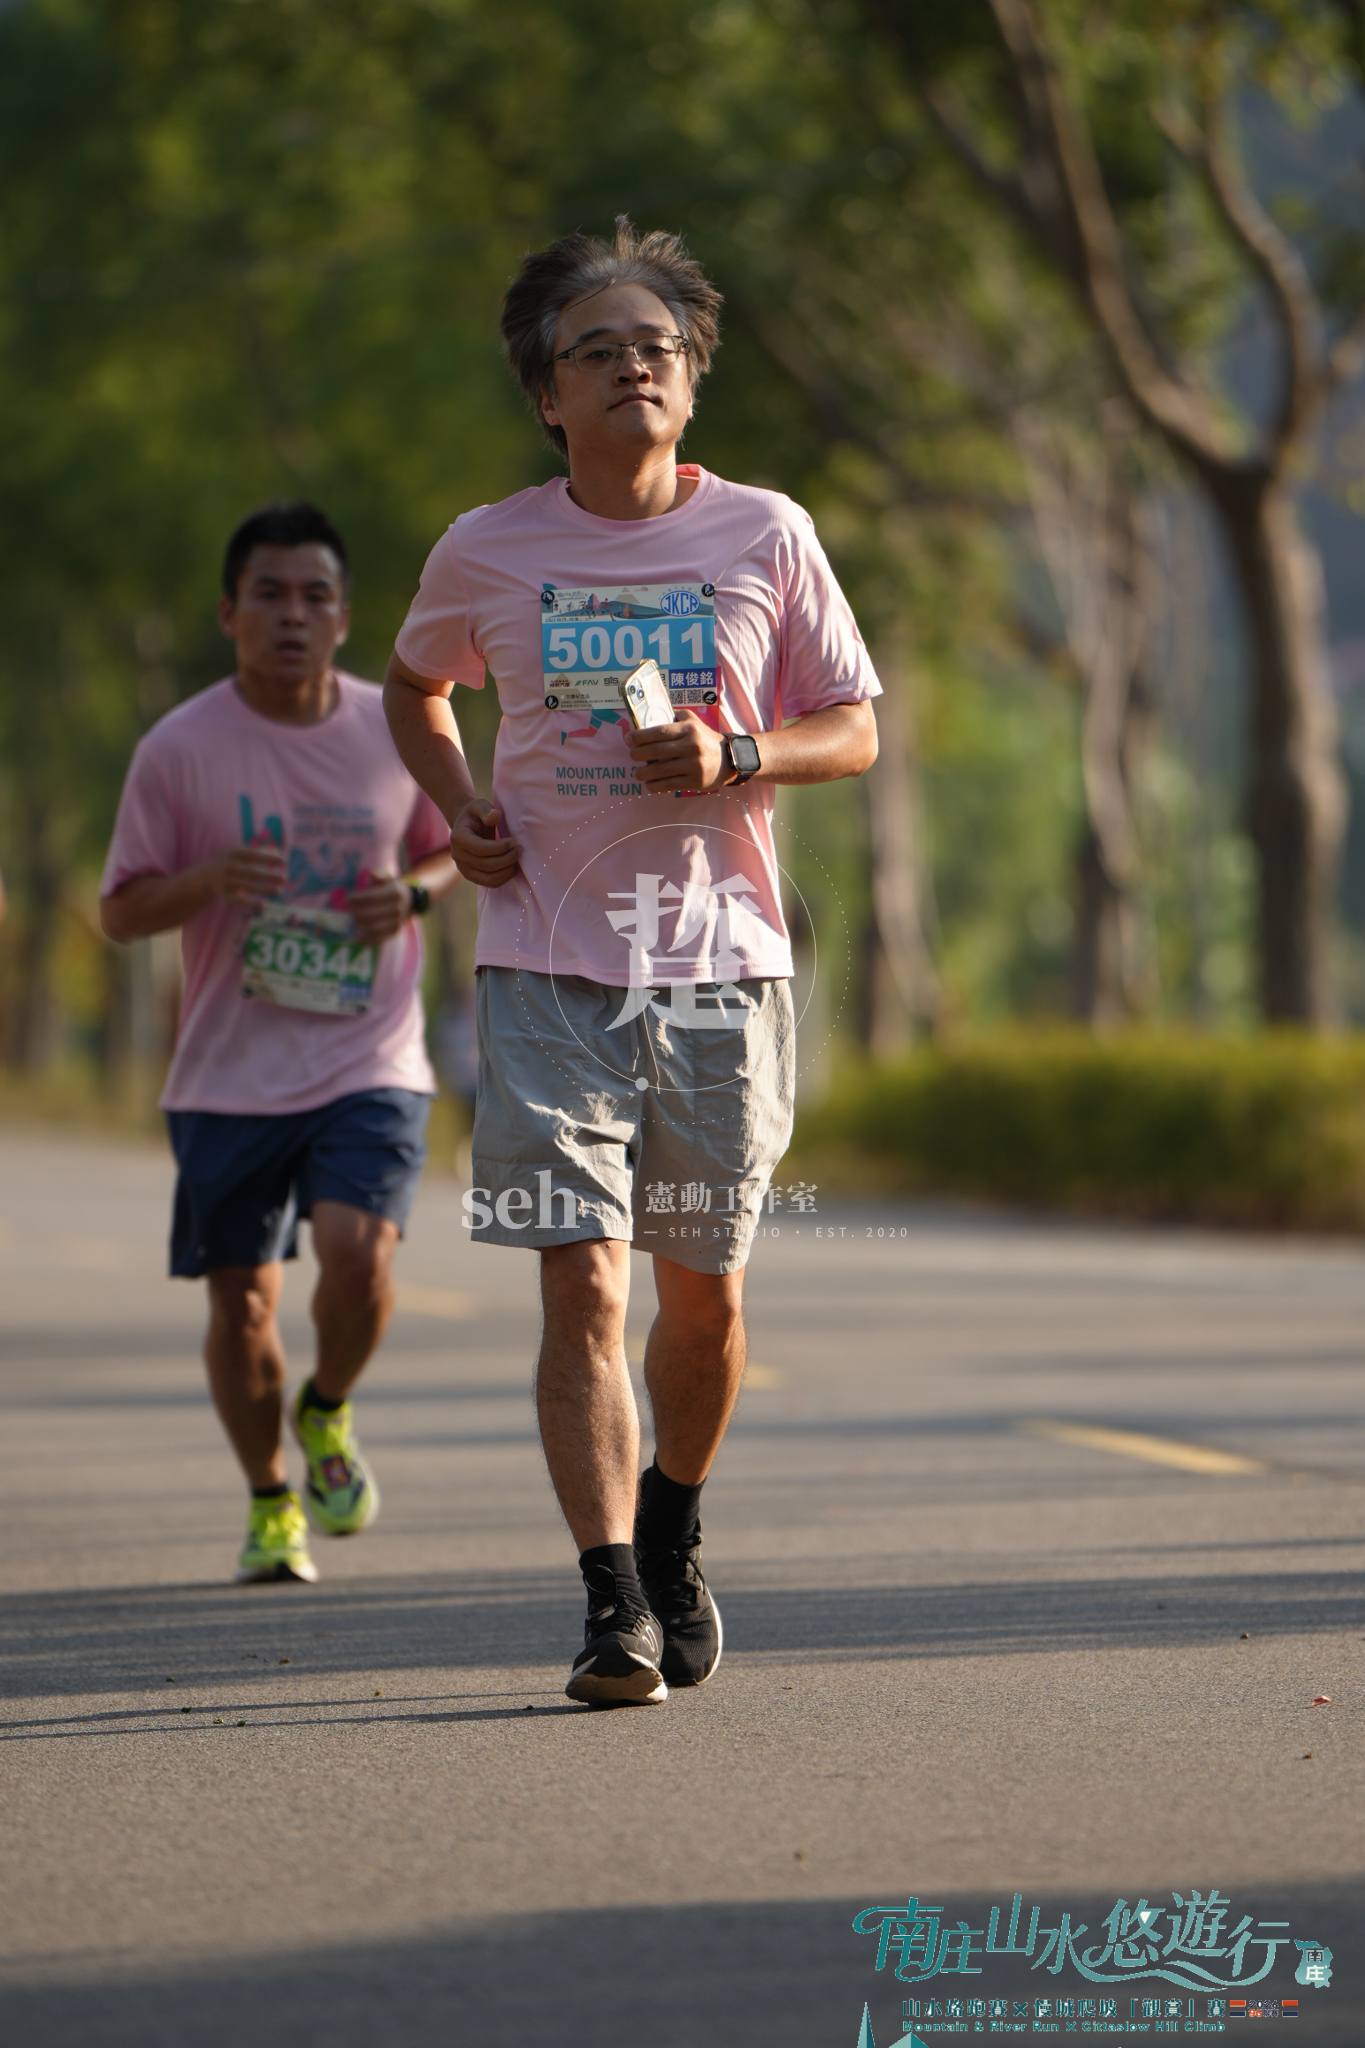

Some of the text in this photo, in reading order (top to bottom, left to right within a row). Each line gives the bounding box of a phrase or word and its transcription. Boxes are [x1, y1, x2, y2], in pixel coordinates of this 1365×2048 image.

[548, 623, 704, 670] 50011
[582, 679, 599, 687] FAV
[671, 672, 714, 687] 陳俊銘
[556, 767, 626, 780] MOUNTAIN
[557, 784, 642, 796] RIVER RUN
[250, 934, 372, 981] 30344
